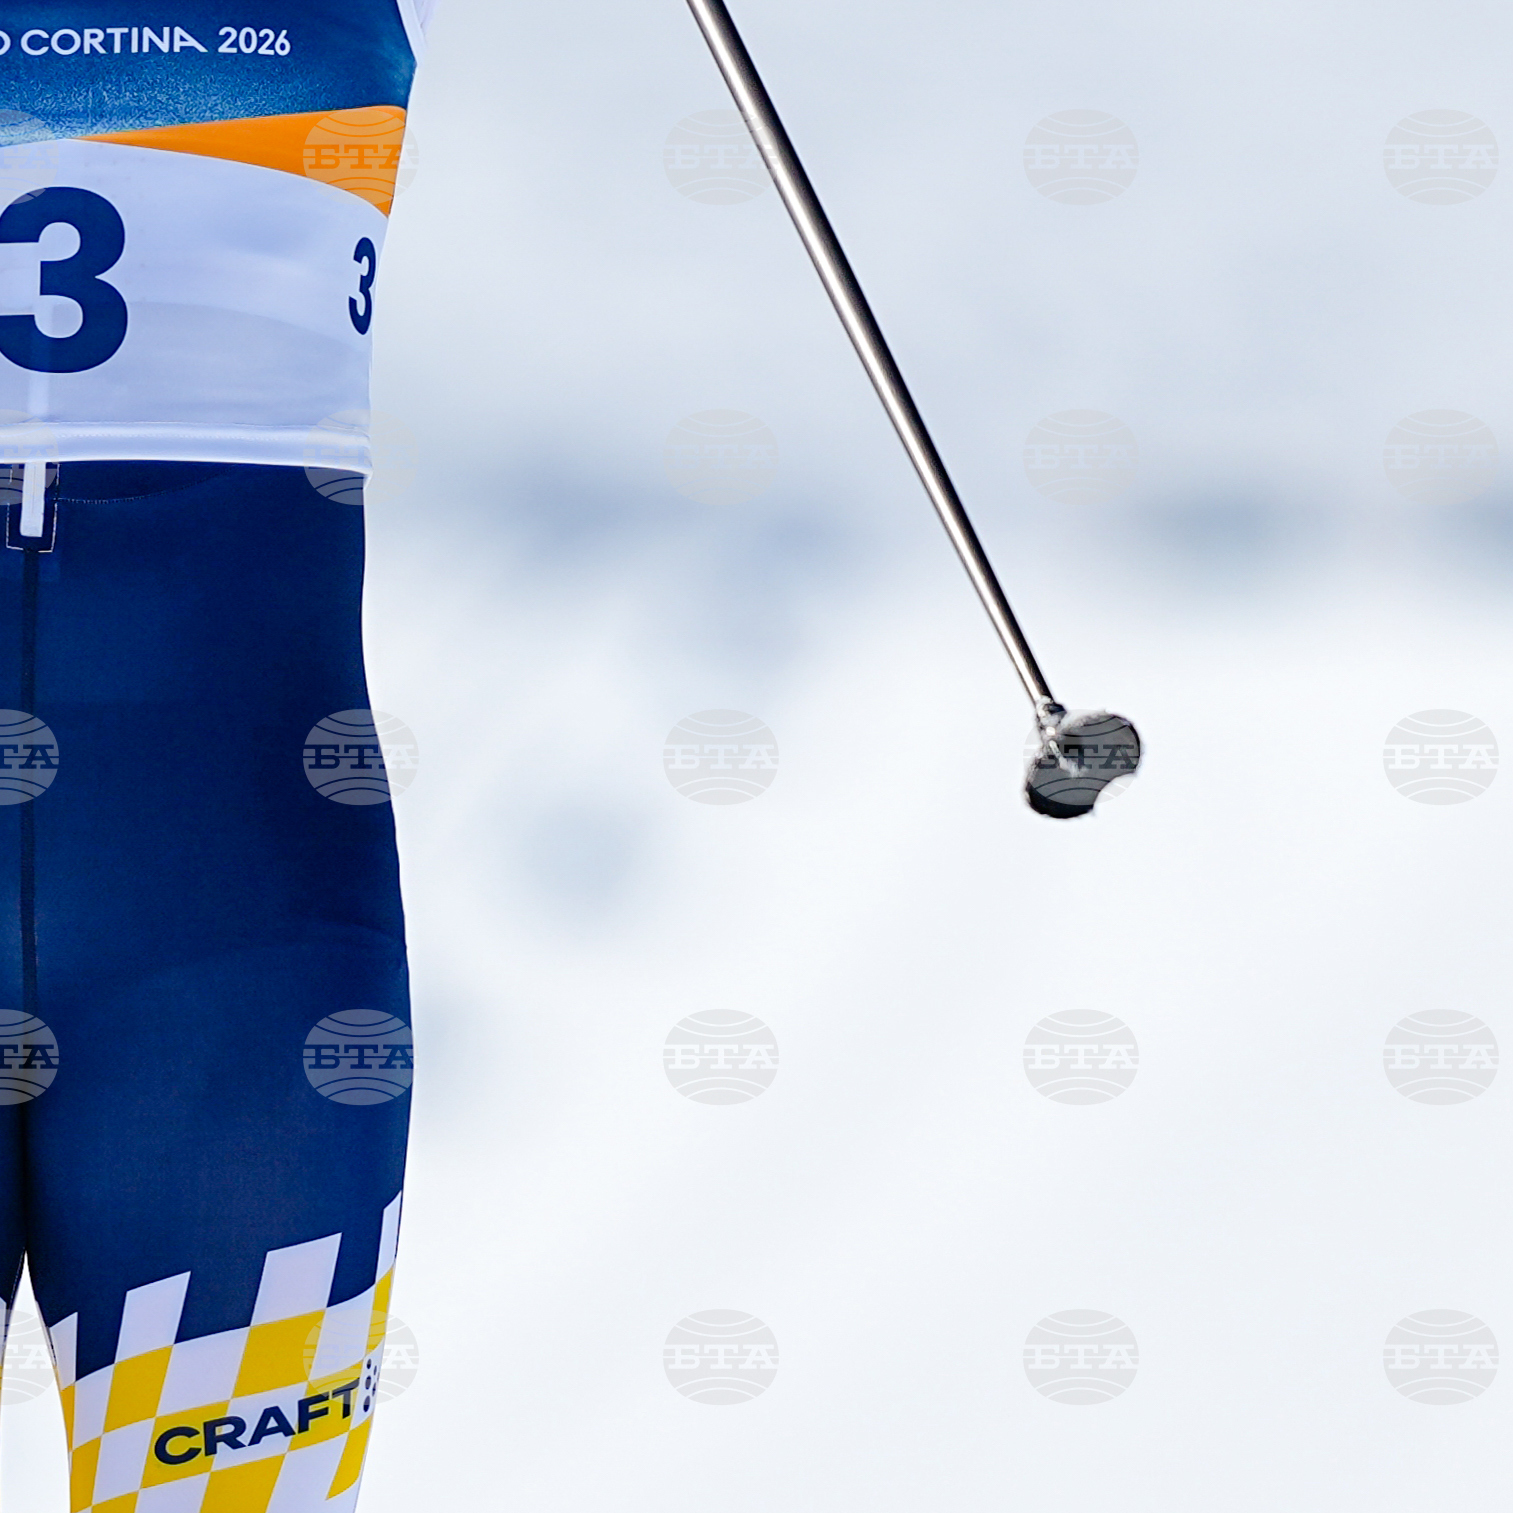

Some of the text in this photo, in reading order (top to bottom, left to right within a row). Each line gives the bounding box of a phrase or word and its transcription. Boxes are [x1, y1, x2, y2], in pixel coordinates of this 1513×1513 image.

[19, 25, 209, 57] CORTINA
[217, 25, 292, 57] 2026
[347, 236, 378, 336] 3
[153, 1376, 362, 1466] CRAFT
